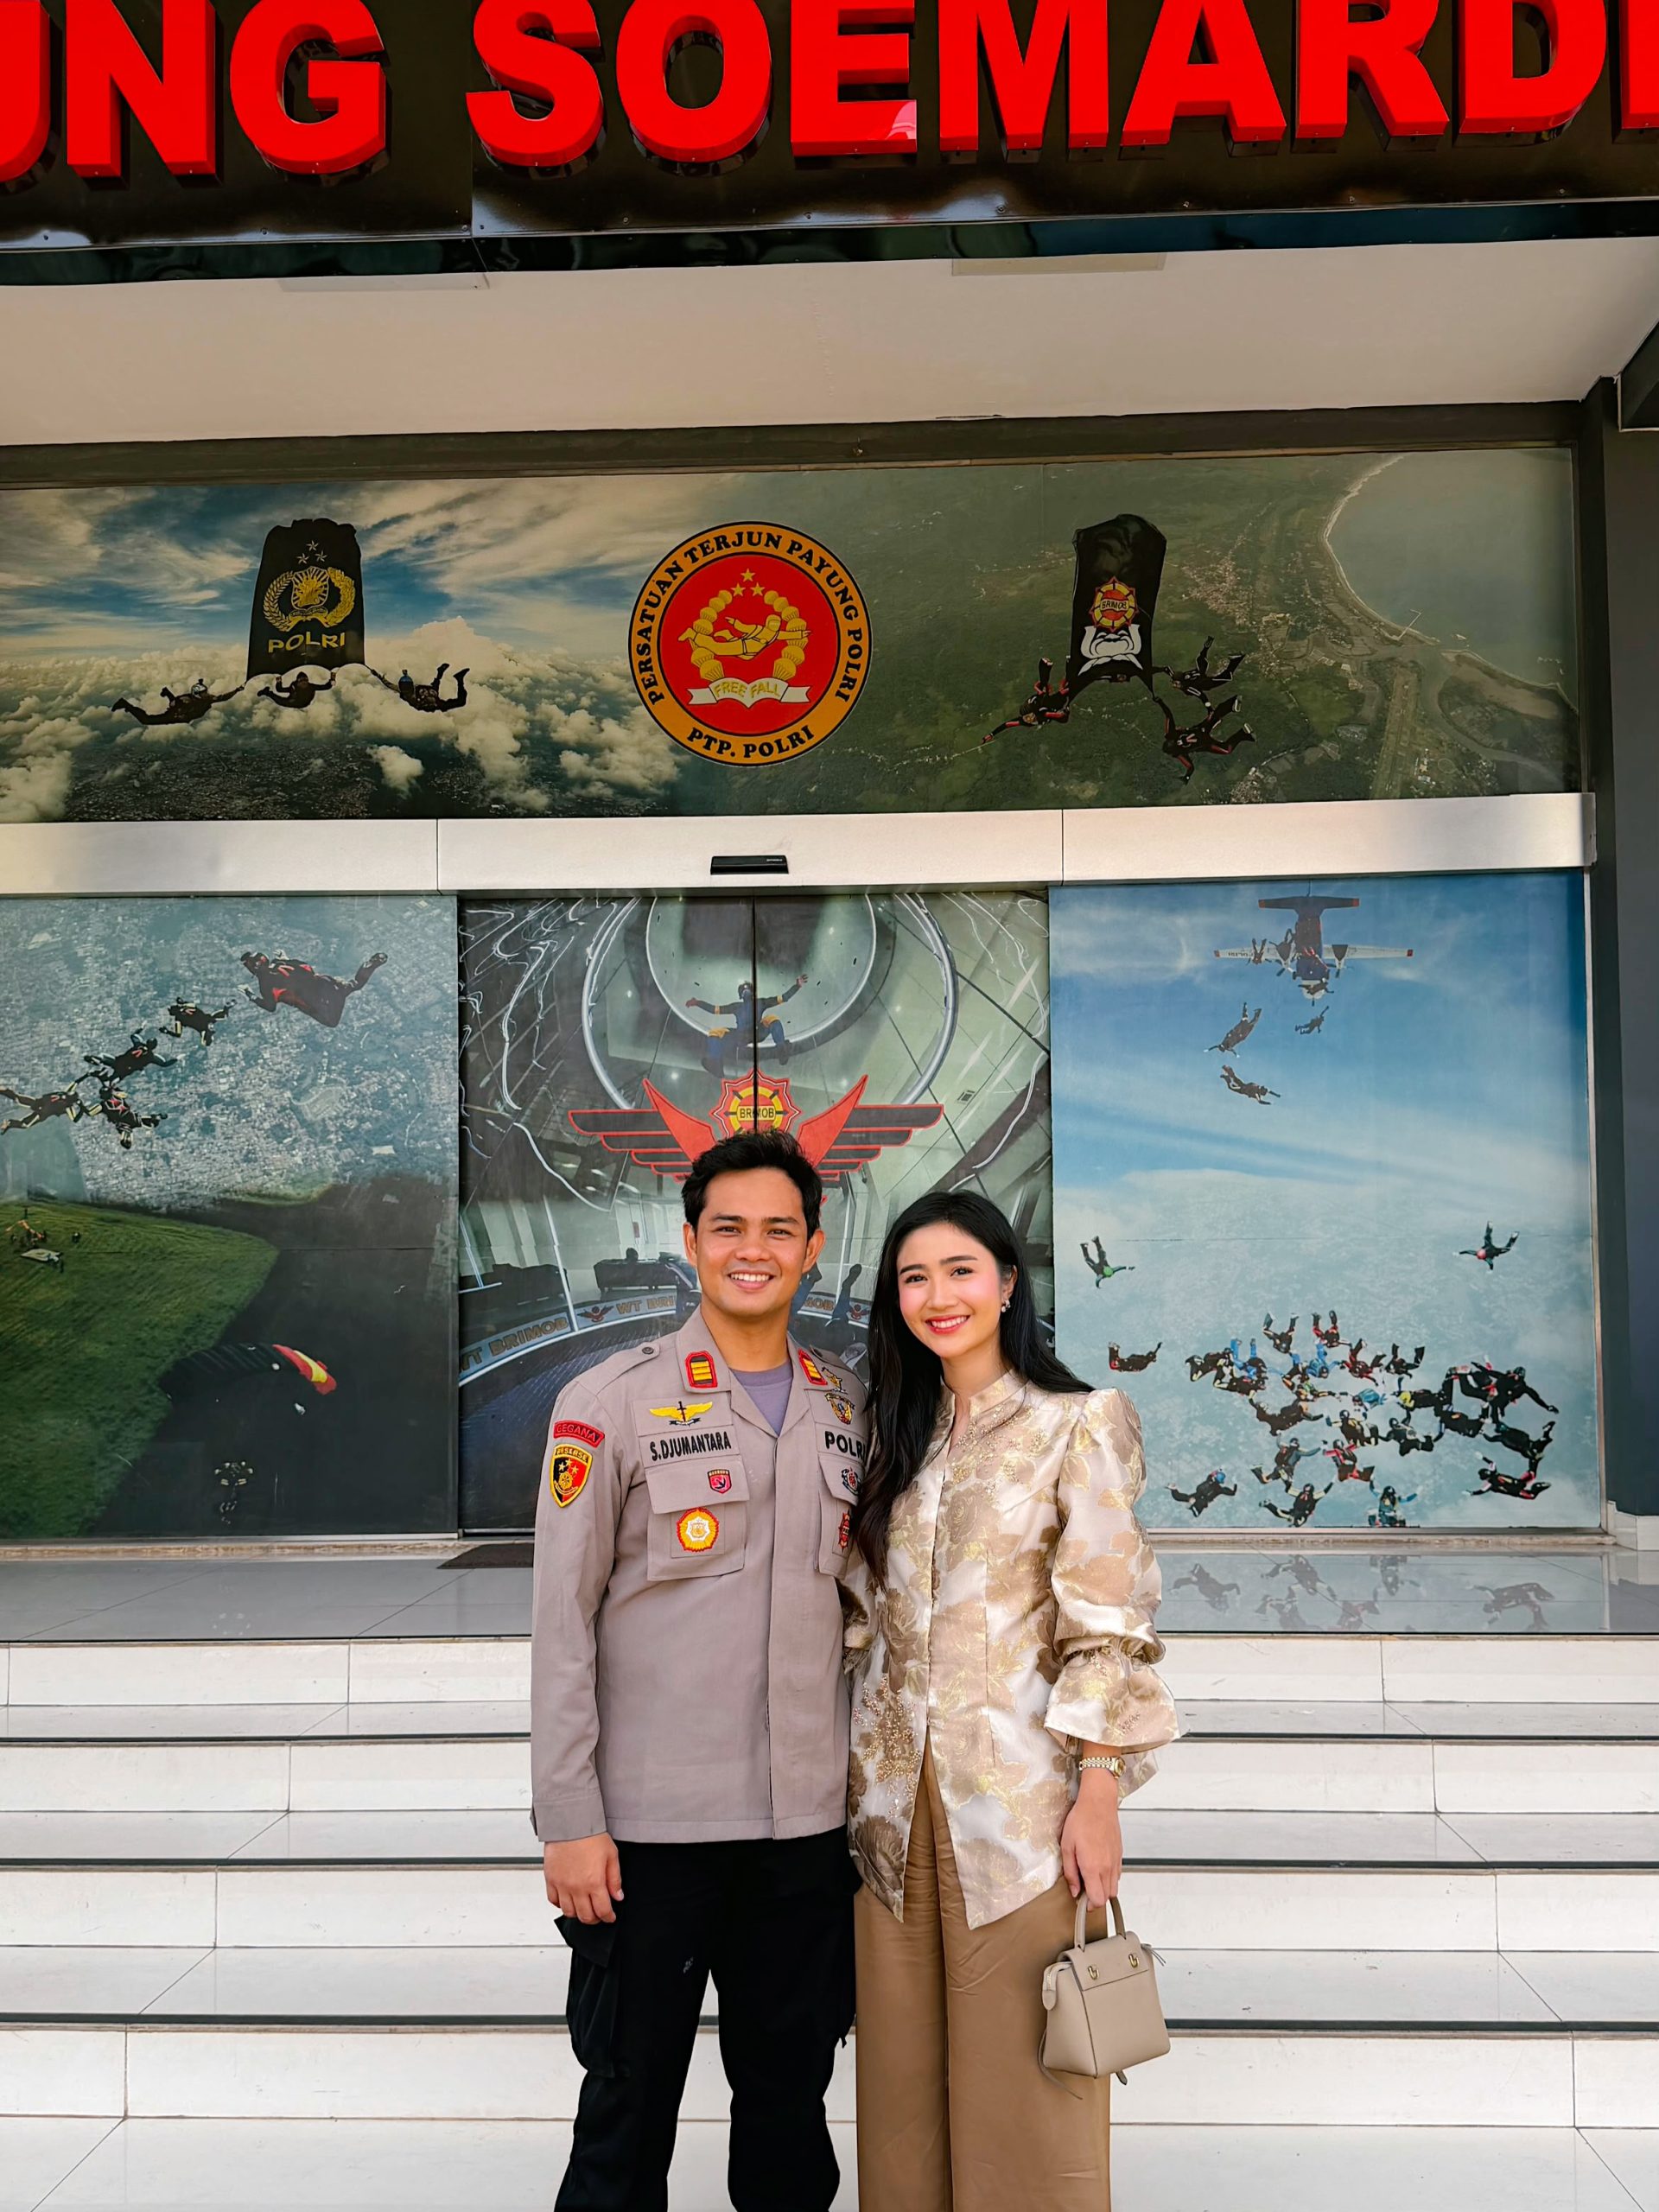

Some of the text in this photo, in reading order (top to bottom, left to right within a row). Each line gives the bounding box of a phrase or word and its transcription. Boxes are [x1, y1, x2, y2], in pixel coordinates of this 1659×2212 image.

[636, 531, 863, 705] PERSATUAN TERJUN PAYUNG POLRI
[268, 632, 345, 653] POLRI
[714, 681, 780, 698] FREE FALL
[687, 724, 815, 759] PTP. POLRI
[616, 1300, 642, 1314] WT
[489, 1317, 569, 1357] BRIMOB
[650, 1432, 732, 1462] S.DJUMANTARA
